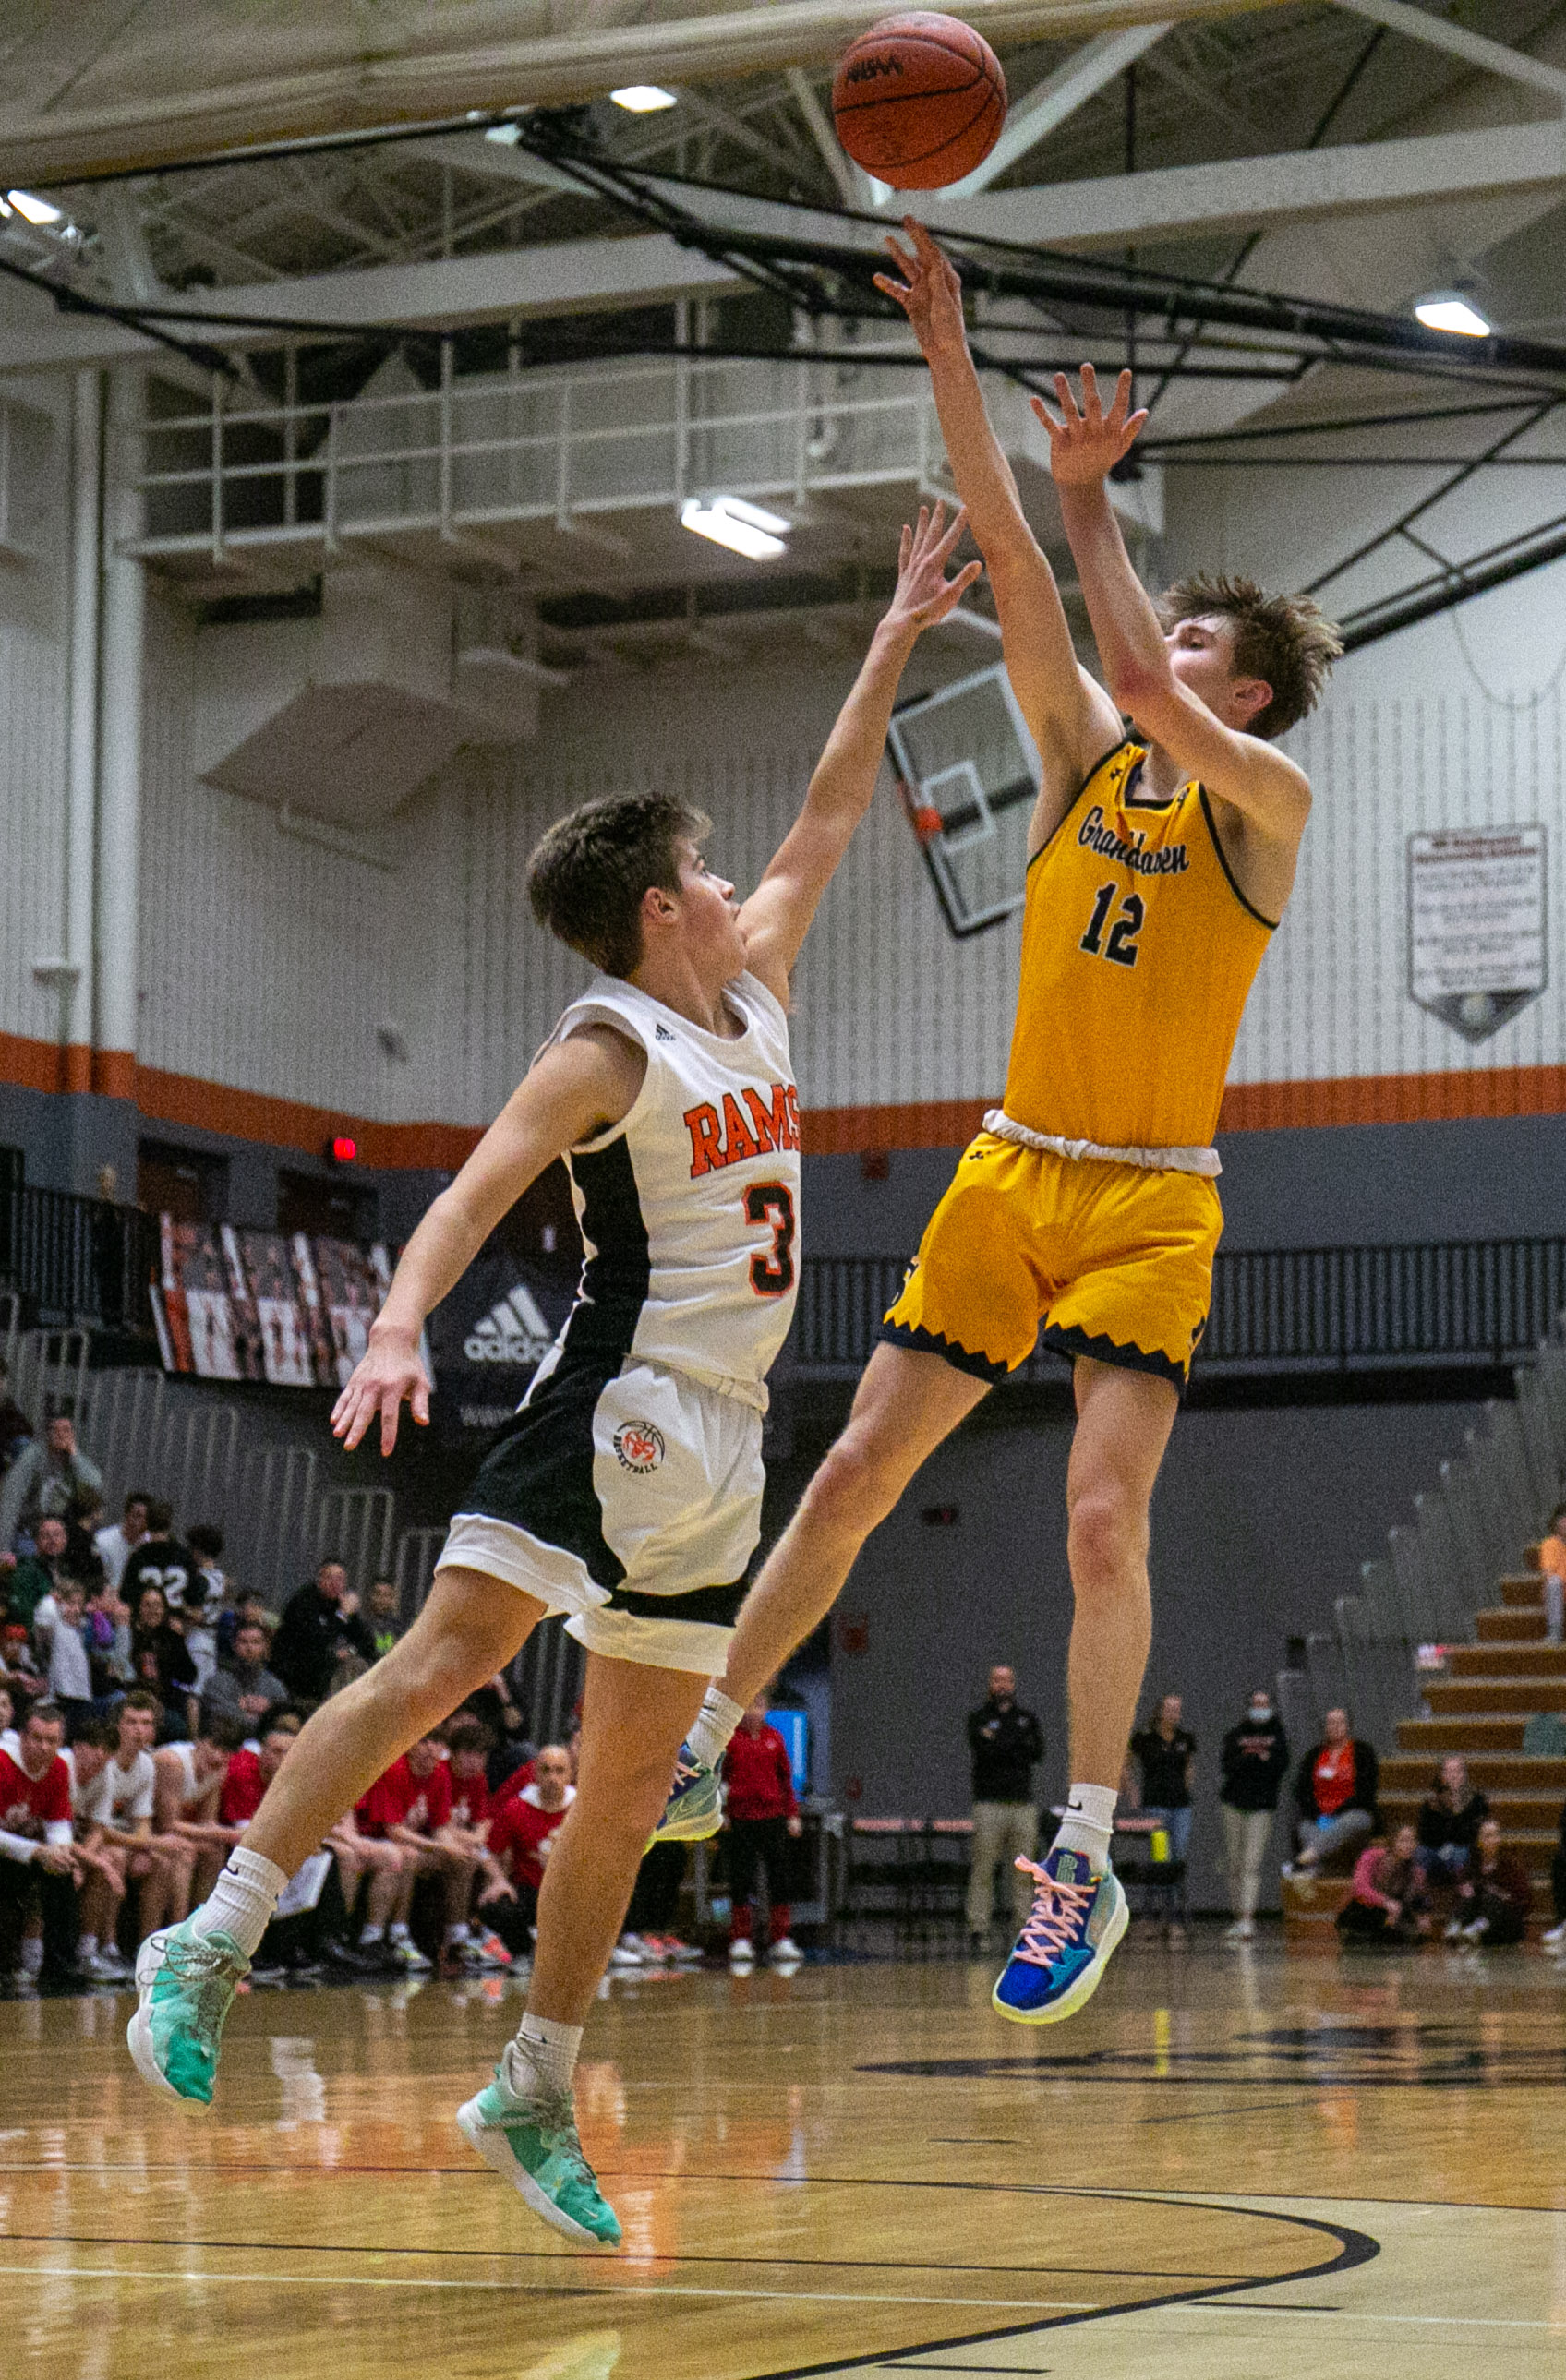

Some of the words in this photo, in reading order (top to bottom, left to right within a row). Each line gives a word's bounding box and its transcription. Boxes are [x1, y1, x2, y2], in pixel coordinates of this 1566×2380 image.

[1079, 880, 1146, 967] 12
[741, 1181, 795, 1298] 3
[464, 1335, 558, 1364] adida
